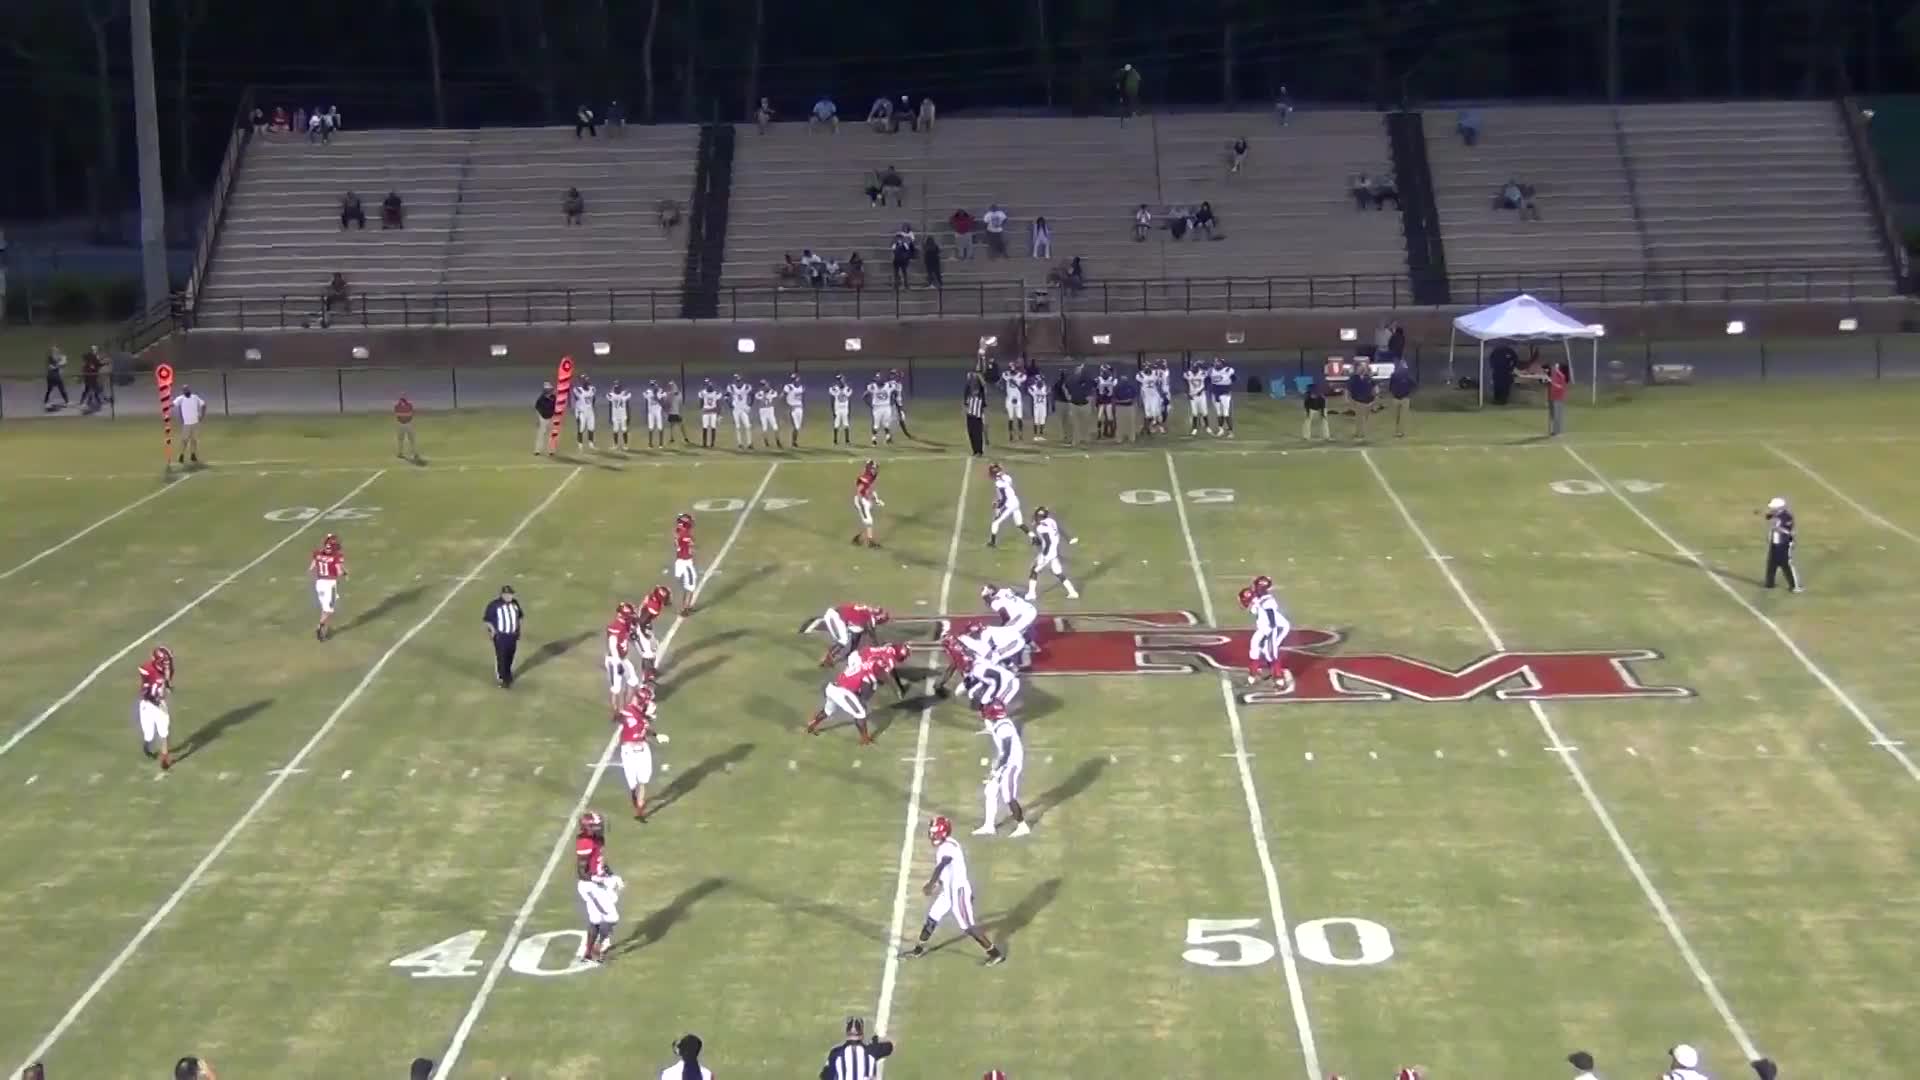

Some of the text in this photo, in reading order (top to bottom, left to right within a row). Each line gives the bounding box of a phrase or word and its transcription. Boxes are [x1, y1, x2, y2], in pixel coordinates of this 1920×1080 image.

[1119, 488, 1236, 504] 50
[389, 929, 601, 978] 40
[1181, 917, 1395, 967] 50
